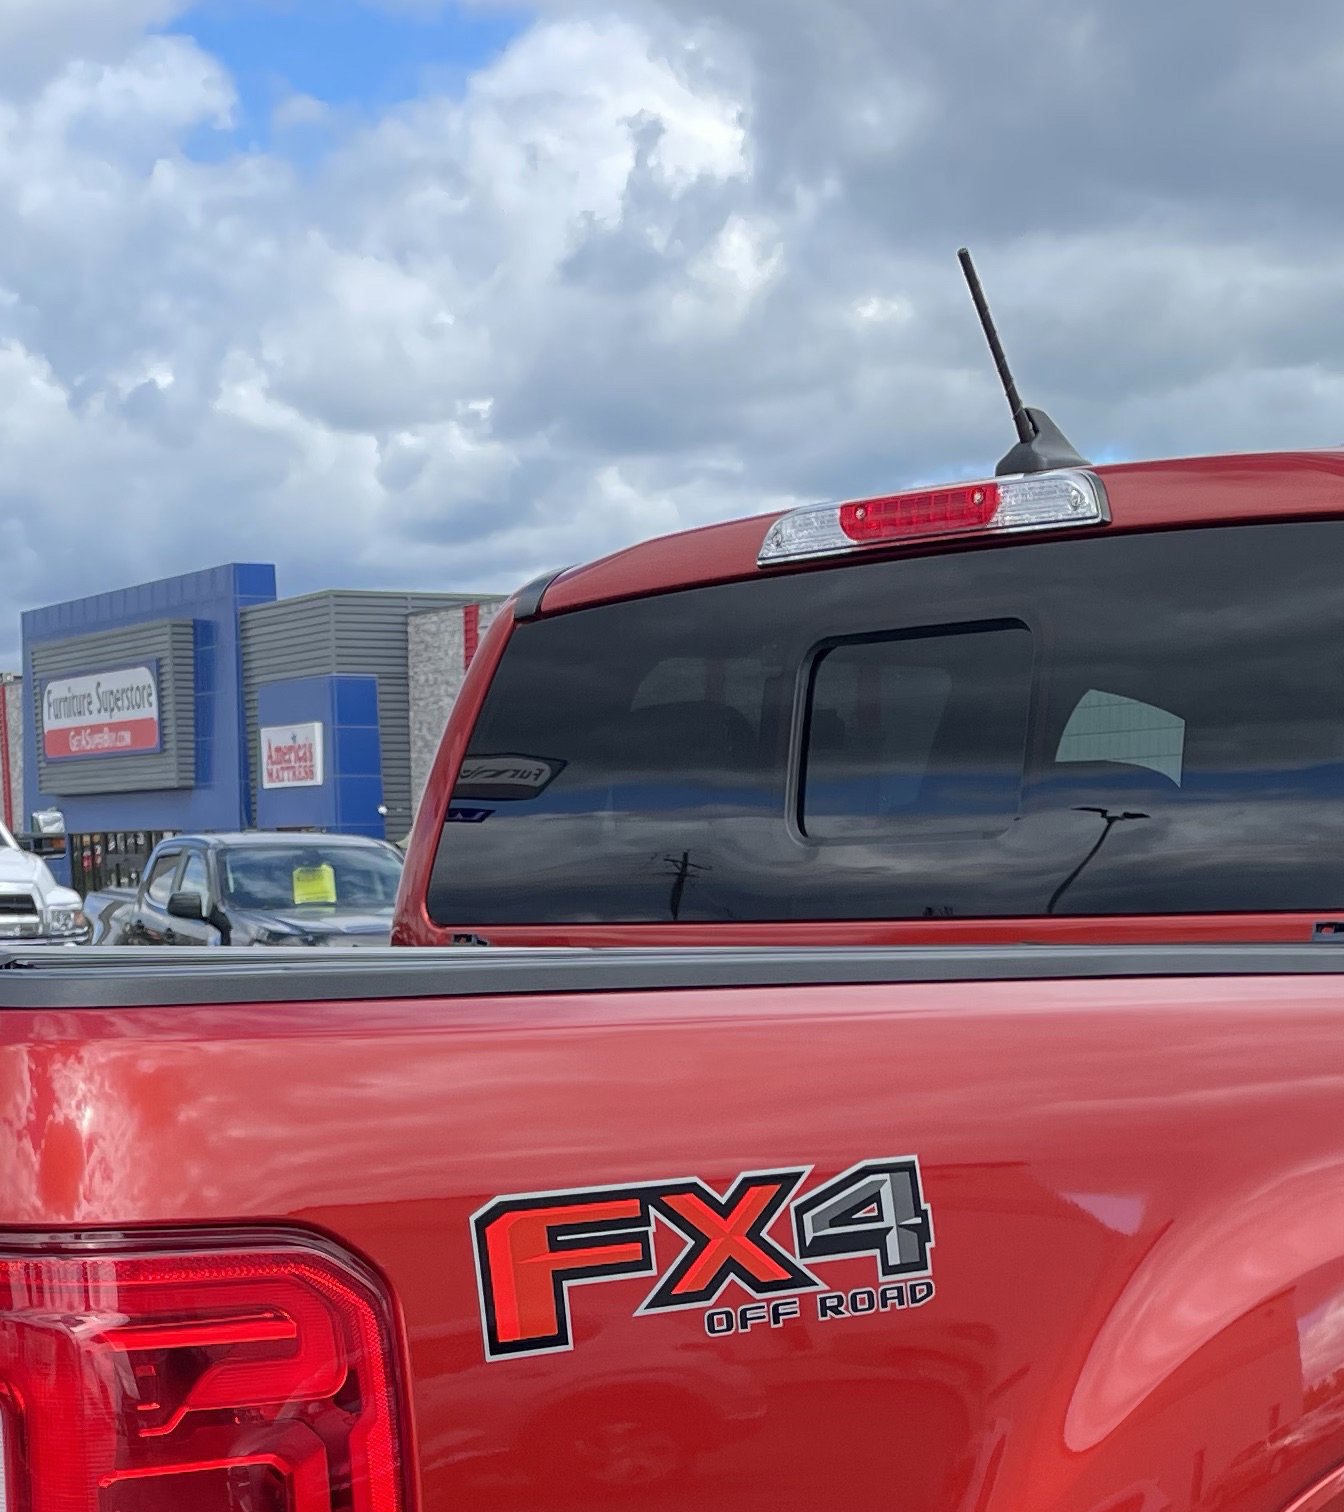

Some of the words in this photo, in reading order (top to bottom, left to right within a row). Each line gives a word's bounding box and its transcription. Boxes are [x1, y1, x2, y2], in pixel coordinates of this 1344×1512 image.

[47, 686, 93, 720] Furniture
[96, 681, 153, 719] Superstore
[469, 1155, 936, 1363] FX4
[704, 1298, 801, 1337] OFF
[817, 1279, 936, 1322] ROAD
